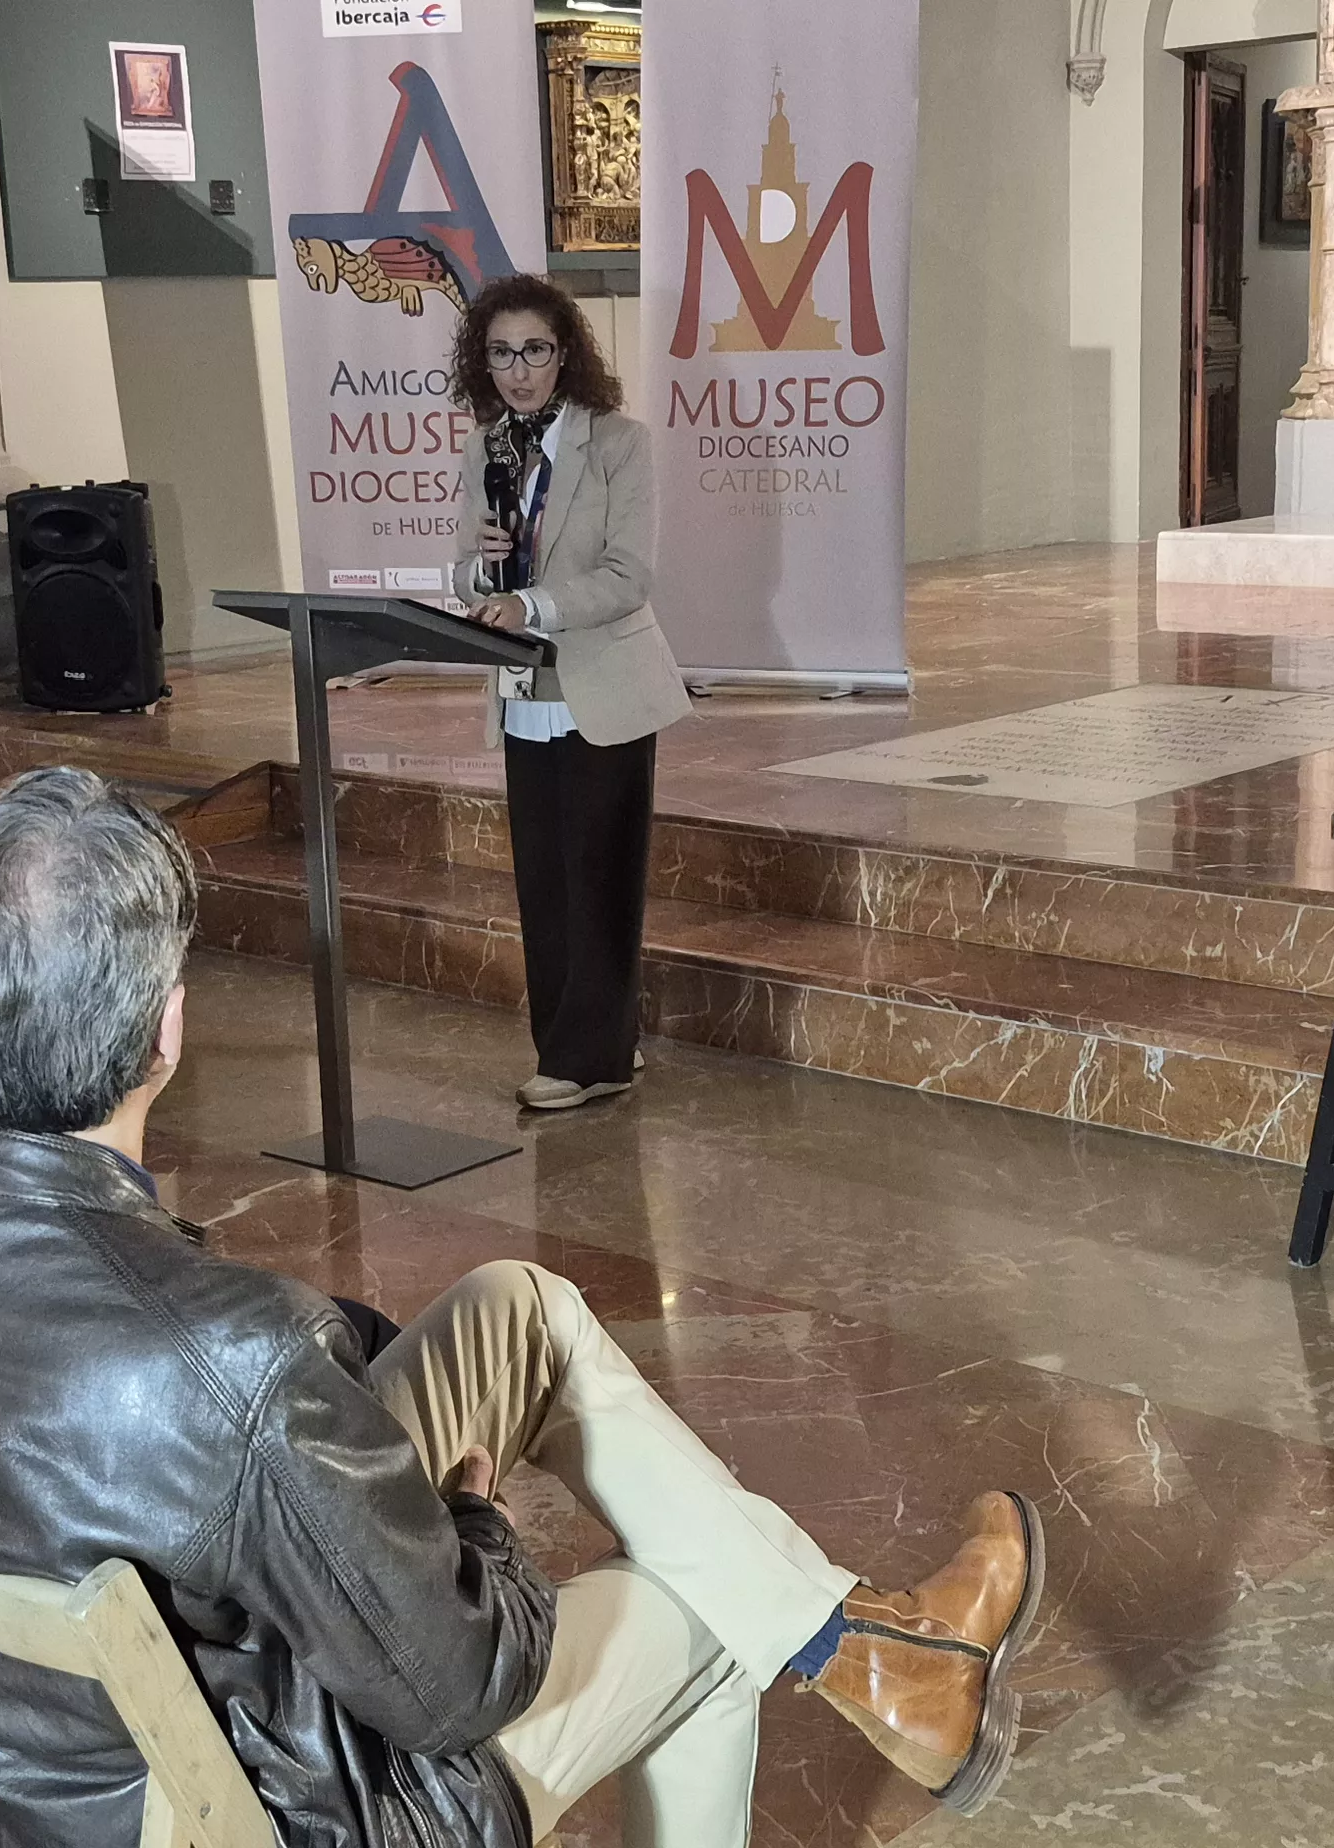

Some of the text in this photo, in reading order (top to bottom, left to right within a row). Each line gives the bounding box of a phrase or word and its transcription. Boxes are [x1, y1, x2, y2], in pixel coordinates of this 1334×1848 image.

[335, 7, 410, 26] Ibercaja
[667, 375, 885, 429] MUSEO
[699, 434, 850, 459] DIOCESANO
[699, 468, 848, 494] CATEDRAL
[728, 502, 817, 517] de HUESCA
[373, 517, 460, 536] DE HUES
